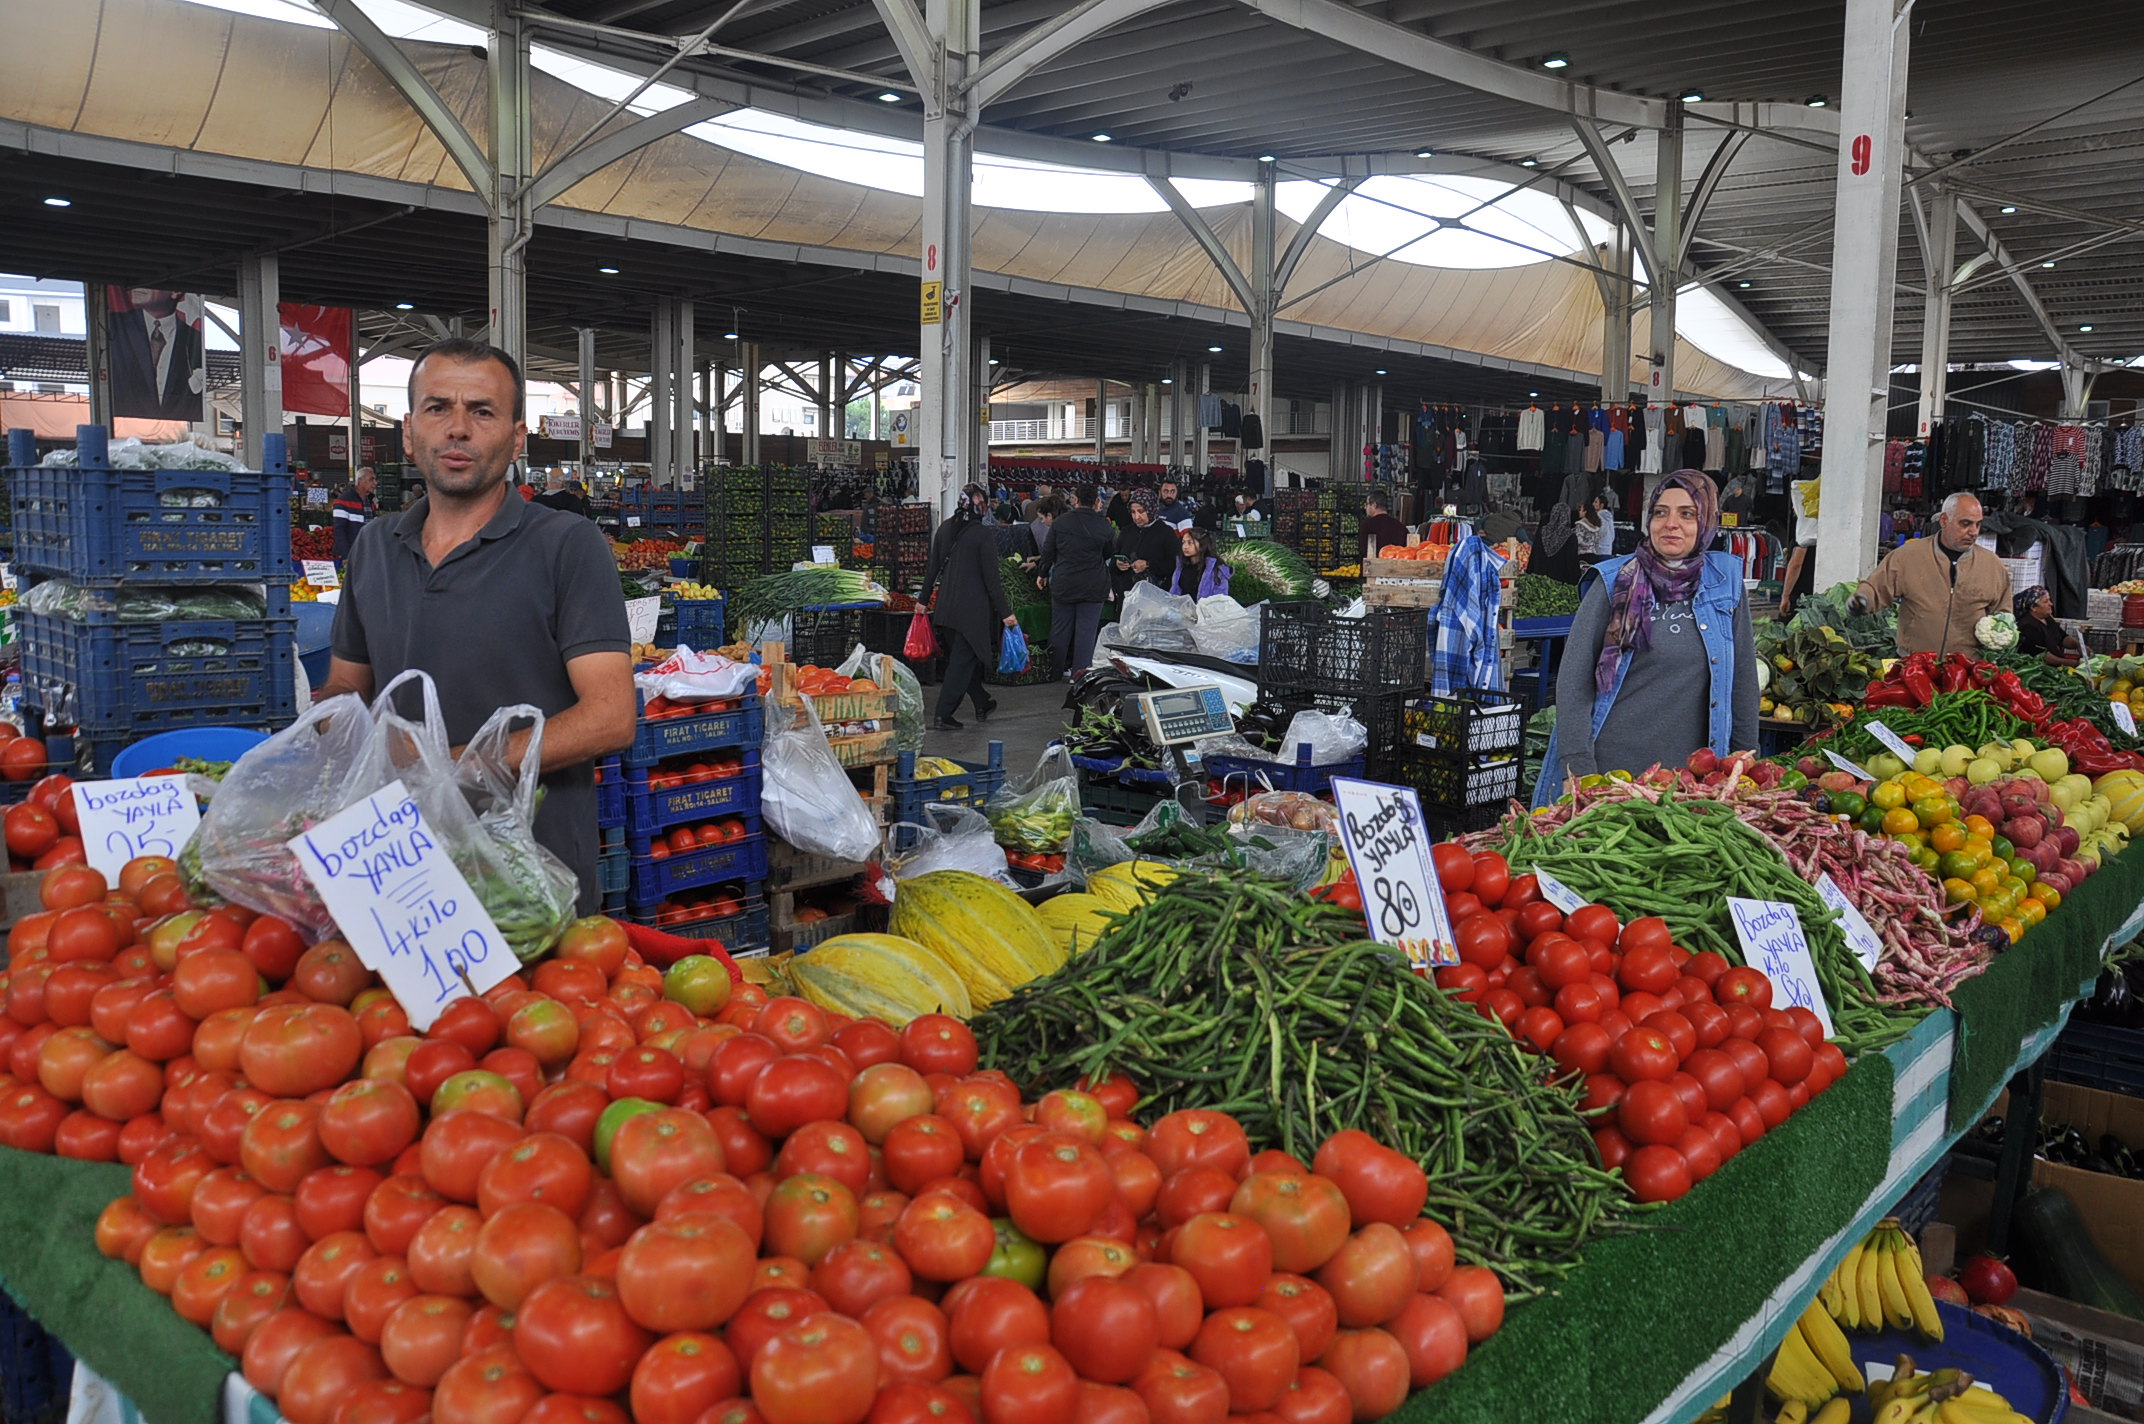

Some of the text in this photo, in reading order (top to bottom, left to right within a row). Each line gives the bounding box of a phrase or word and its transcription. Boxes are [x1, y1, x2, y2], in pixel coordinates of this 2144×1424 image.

[1851, 134, 1872, 176] 9
[927, 244, 937, 271] 8
[491, 308, 497, 328] 7
[268, 345, 277, 362] 6
[1252, 382, 1258, 395] 7
[1653, 371, 1660, 387] 8
[663, 725, 690, 739] FIRAT
[112, 798, 184, 824] YAYLA
[667, 793, 692, 807] FIRAT
[1363, 824, 1416, 873] YAYLA
[348, 830, 433, 895] YAYLA
[1374, 876, 1420, 937] 80
[1758, 931, 1805, 961] YAYLA
[420, 929, 489, 1003] 100
